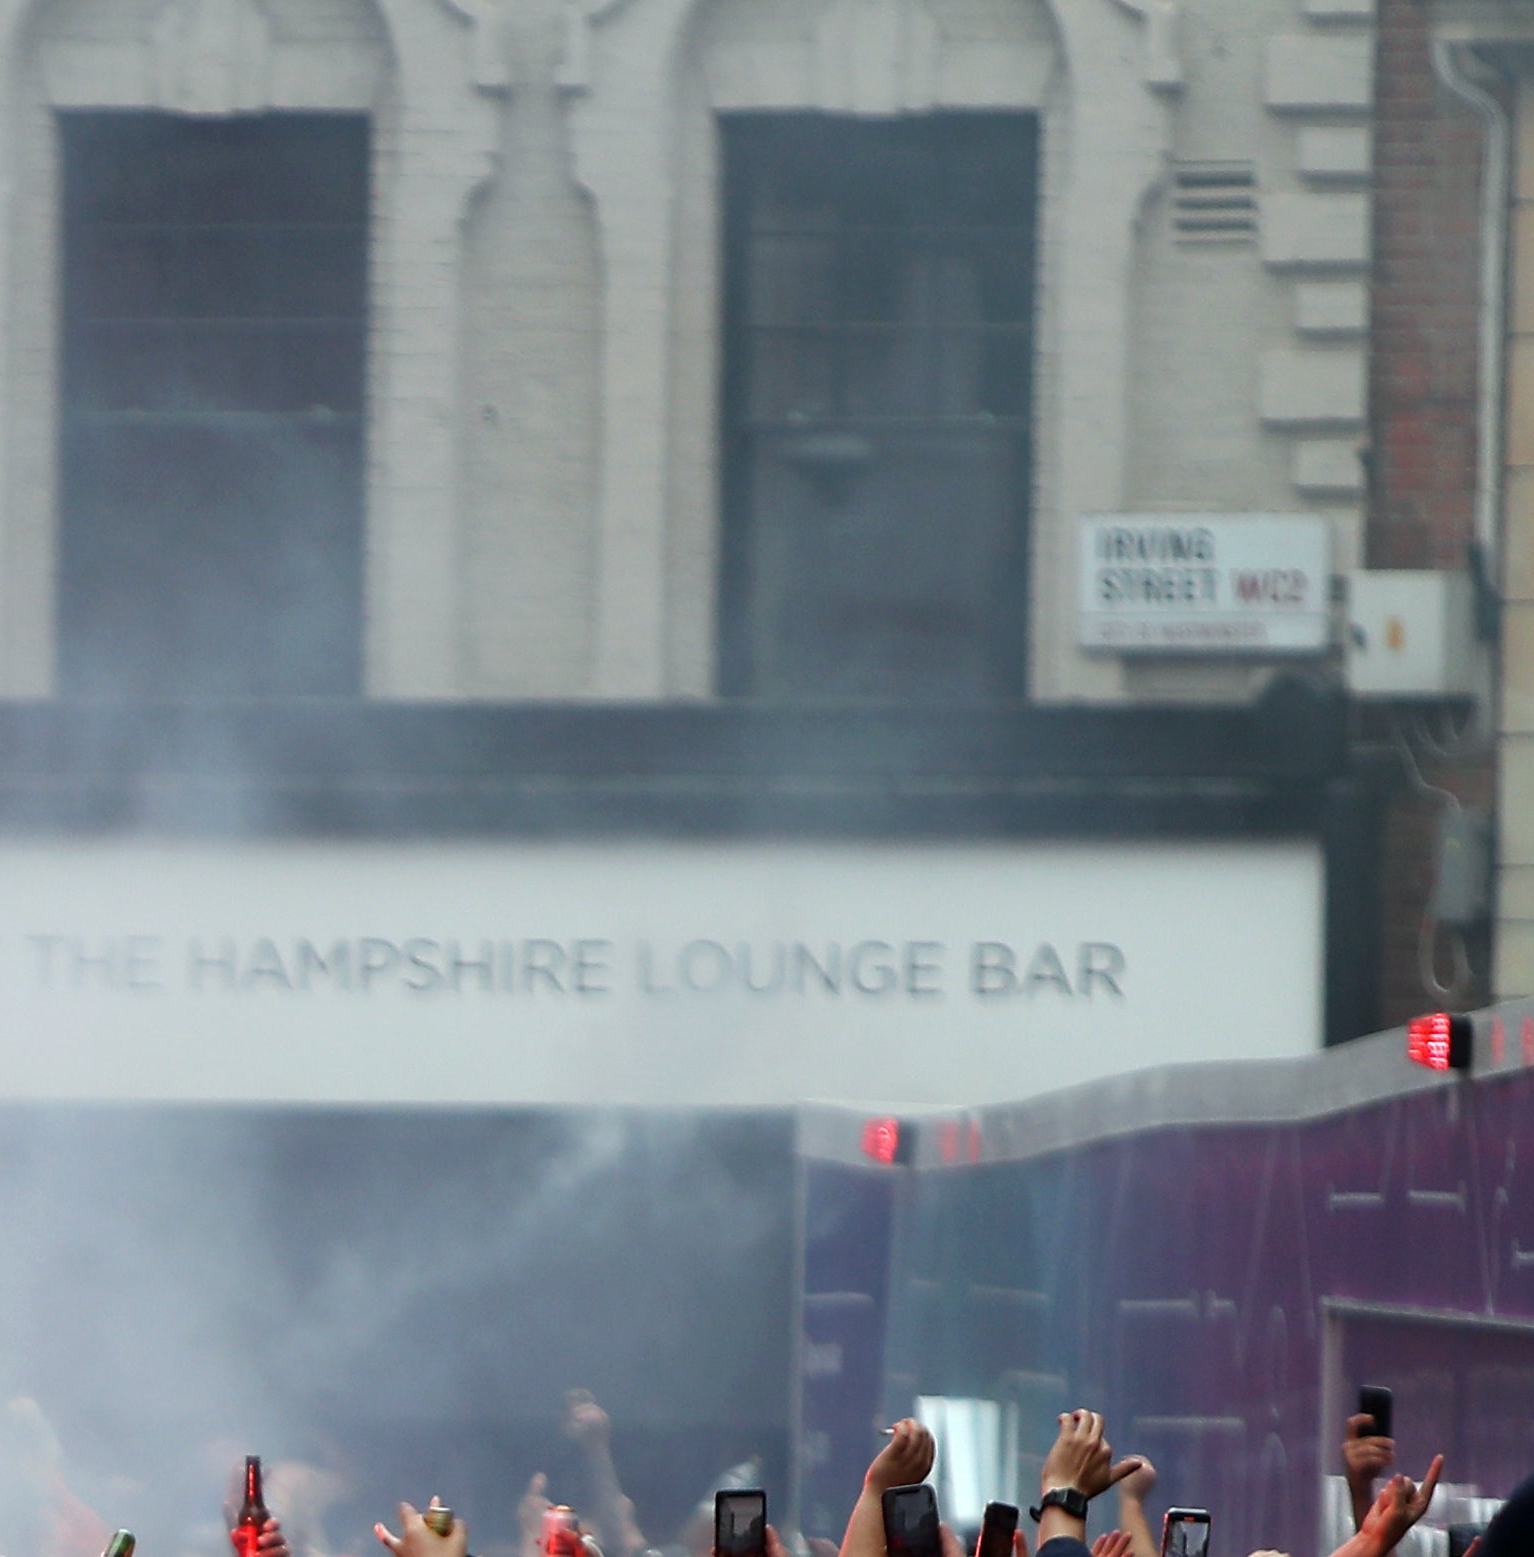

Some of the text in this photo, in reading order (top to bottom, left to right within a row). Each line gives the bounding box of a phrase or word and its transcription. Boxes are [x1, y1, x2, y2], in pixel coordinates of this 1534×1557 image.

[1095, 526, 1215, 560] IRVING
[1097, 567, 1309, 602] STREET WC2
[27, 934, 163, 992] THE
[188, 936, 614, 994] HAMPSHIRE
[639, 938, 946, 996] LOUNGE
[970, 941, 1127, 997] BAR
